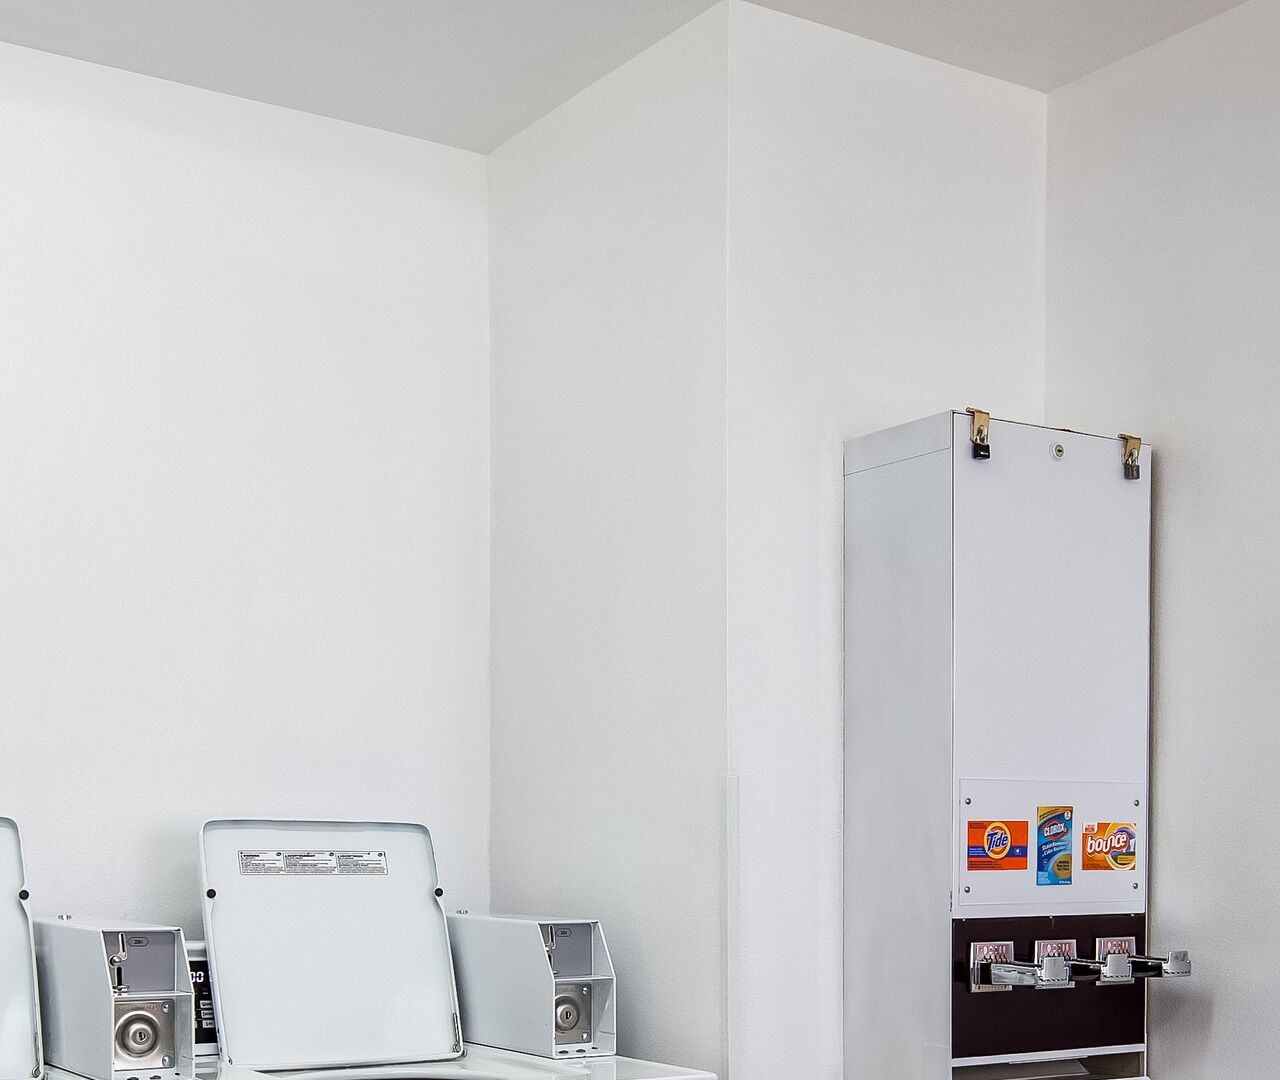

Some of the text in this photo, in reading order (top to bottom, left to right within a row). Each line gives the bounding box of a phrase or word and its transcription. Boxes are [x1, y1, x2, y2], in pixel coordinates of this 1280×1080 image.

[1044, 823, 1065, 836] CLOROX
[986, 831, 1009, 852] Tide
[1087, 834, 1127, 853] bounce
